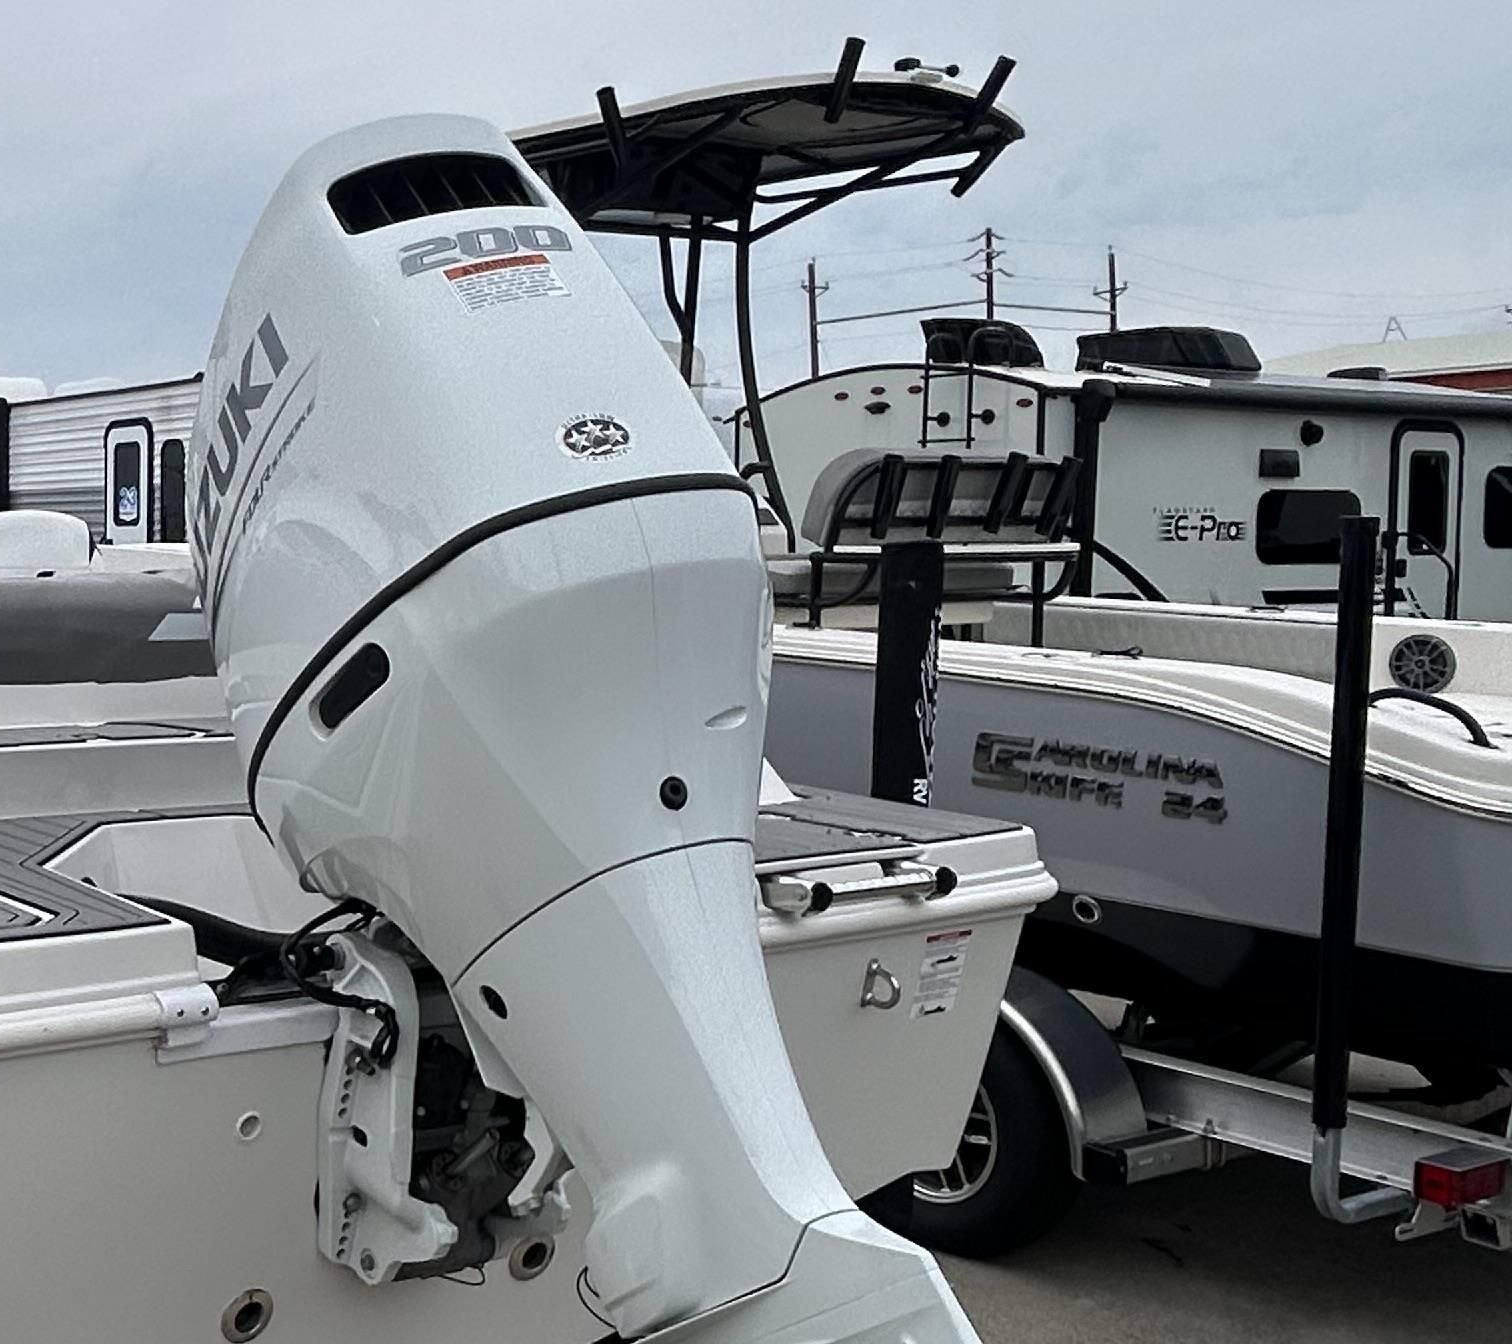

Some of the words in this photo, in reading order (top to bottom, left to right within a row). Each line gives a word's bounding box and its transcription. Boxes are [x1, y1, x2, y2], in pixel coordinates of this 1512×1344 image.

[399, 224, 573, 278] 200
[972, 731, 1224, 790] CAROLINA
[912, 777, 928, 805] RV
[1161, 790, 1228, 825] 24
